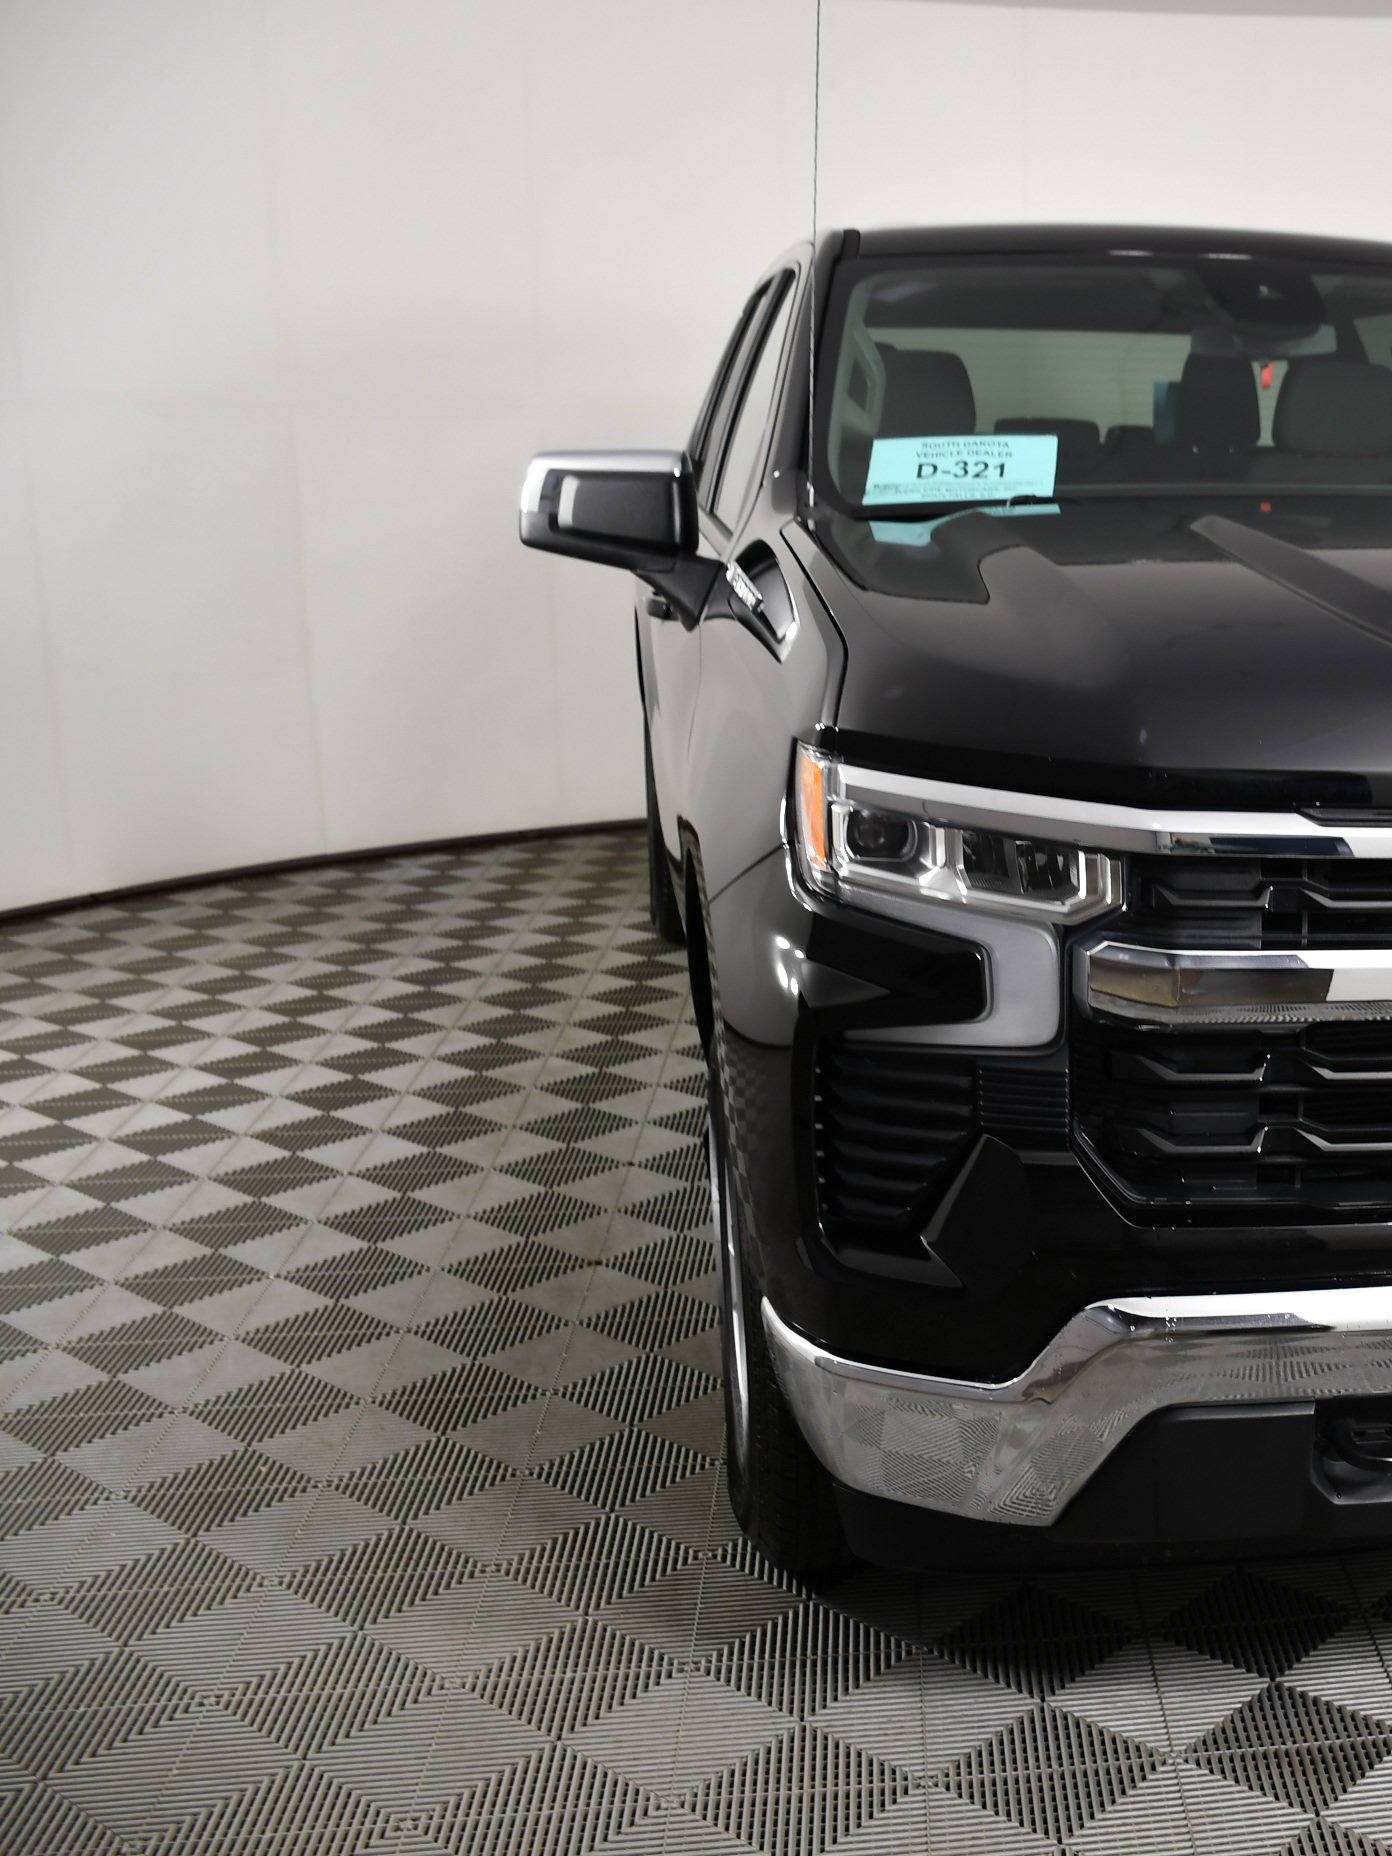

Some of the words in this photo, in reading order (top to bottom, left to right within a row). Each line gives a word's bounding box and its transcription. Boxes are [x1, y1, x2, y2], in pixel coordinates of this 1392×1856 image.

[922, 441, 960, 449] SOUTH
[963, 440, 1009, 449] DAKOTA
[916, 450, 962, 458] VEHICLE
[967, 449, 1013, 458] DEALER
[916, 460, 1006, 479] D-321
